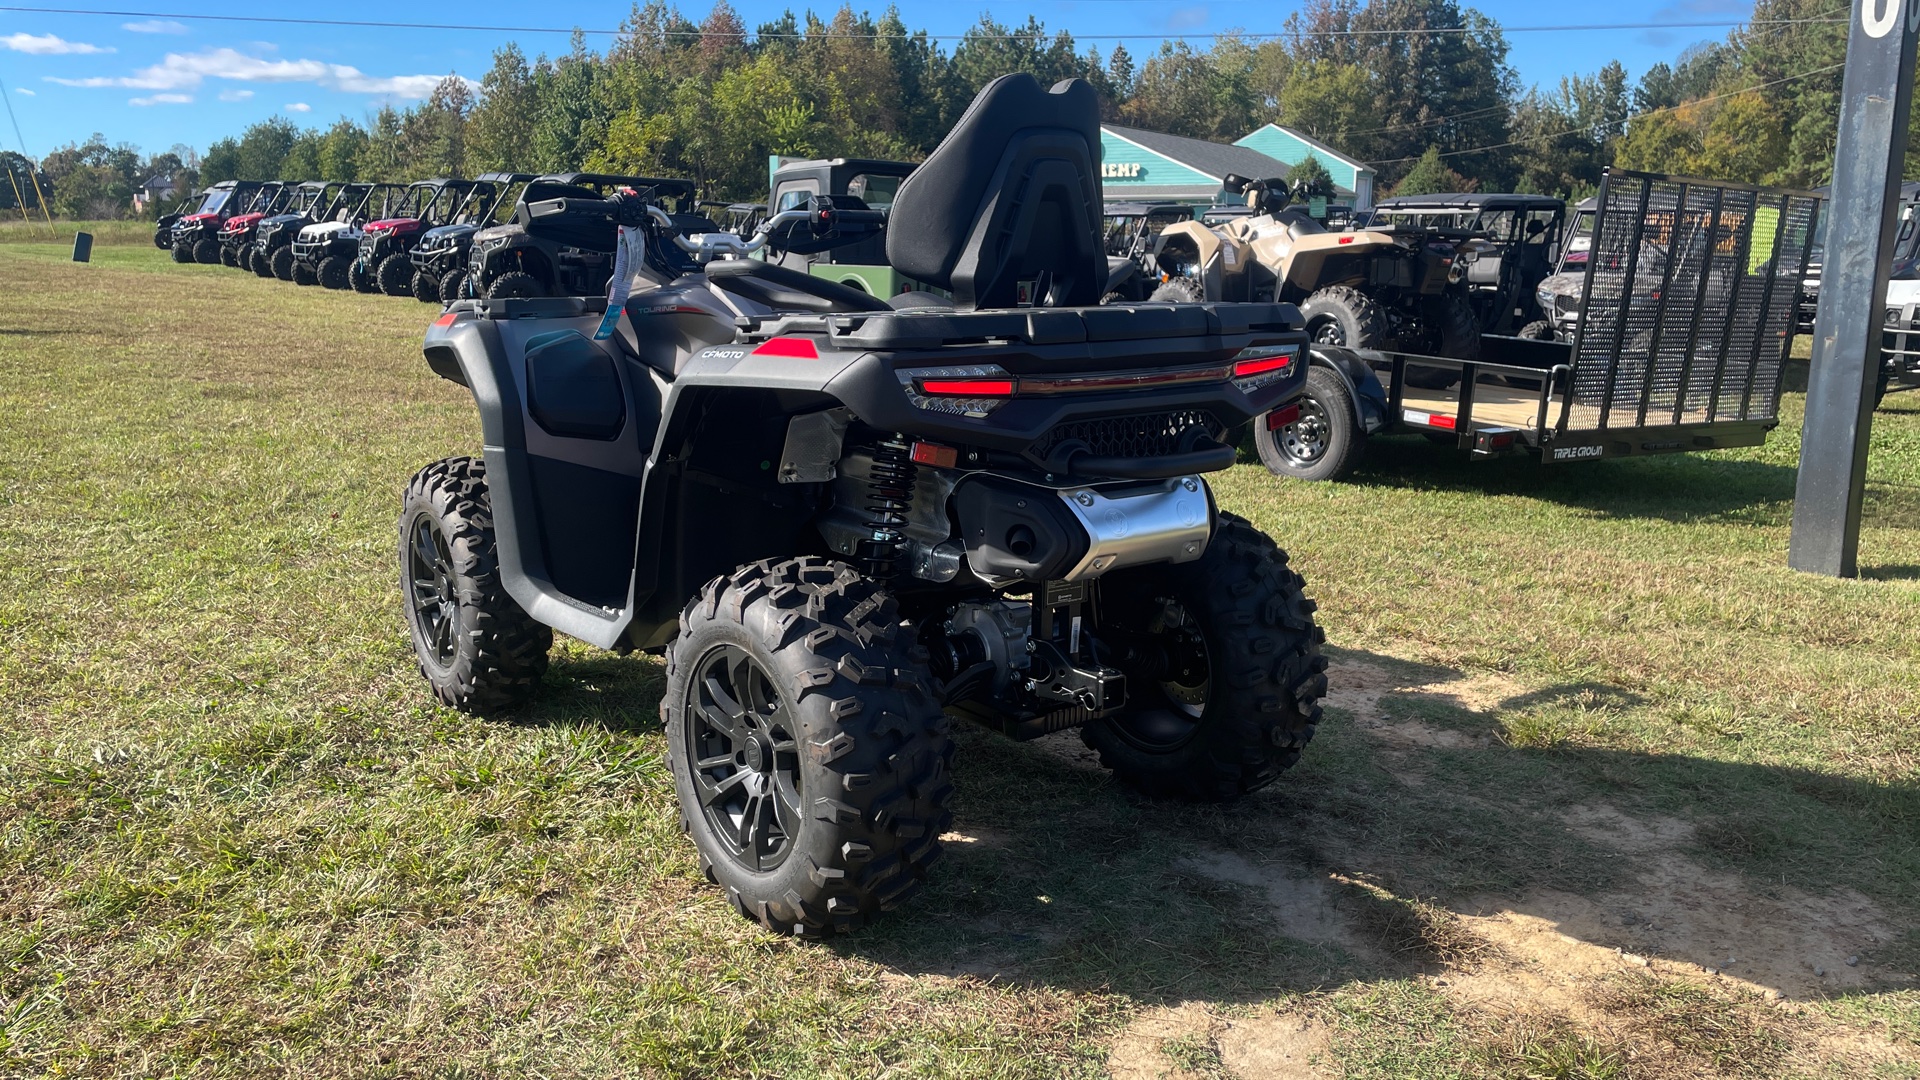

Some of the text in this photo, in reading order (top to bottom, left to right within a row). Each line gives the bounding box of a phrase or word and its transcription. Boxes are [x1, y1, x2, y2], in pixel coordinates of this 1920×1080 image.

[701, 350, 745, 359] CFMOTO
[1554, 445, 1603, 459] TRIPLE CROWN
